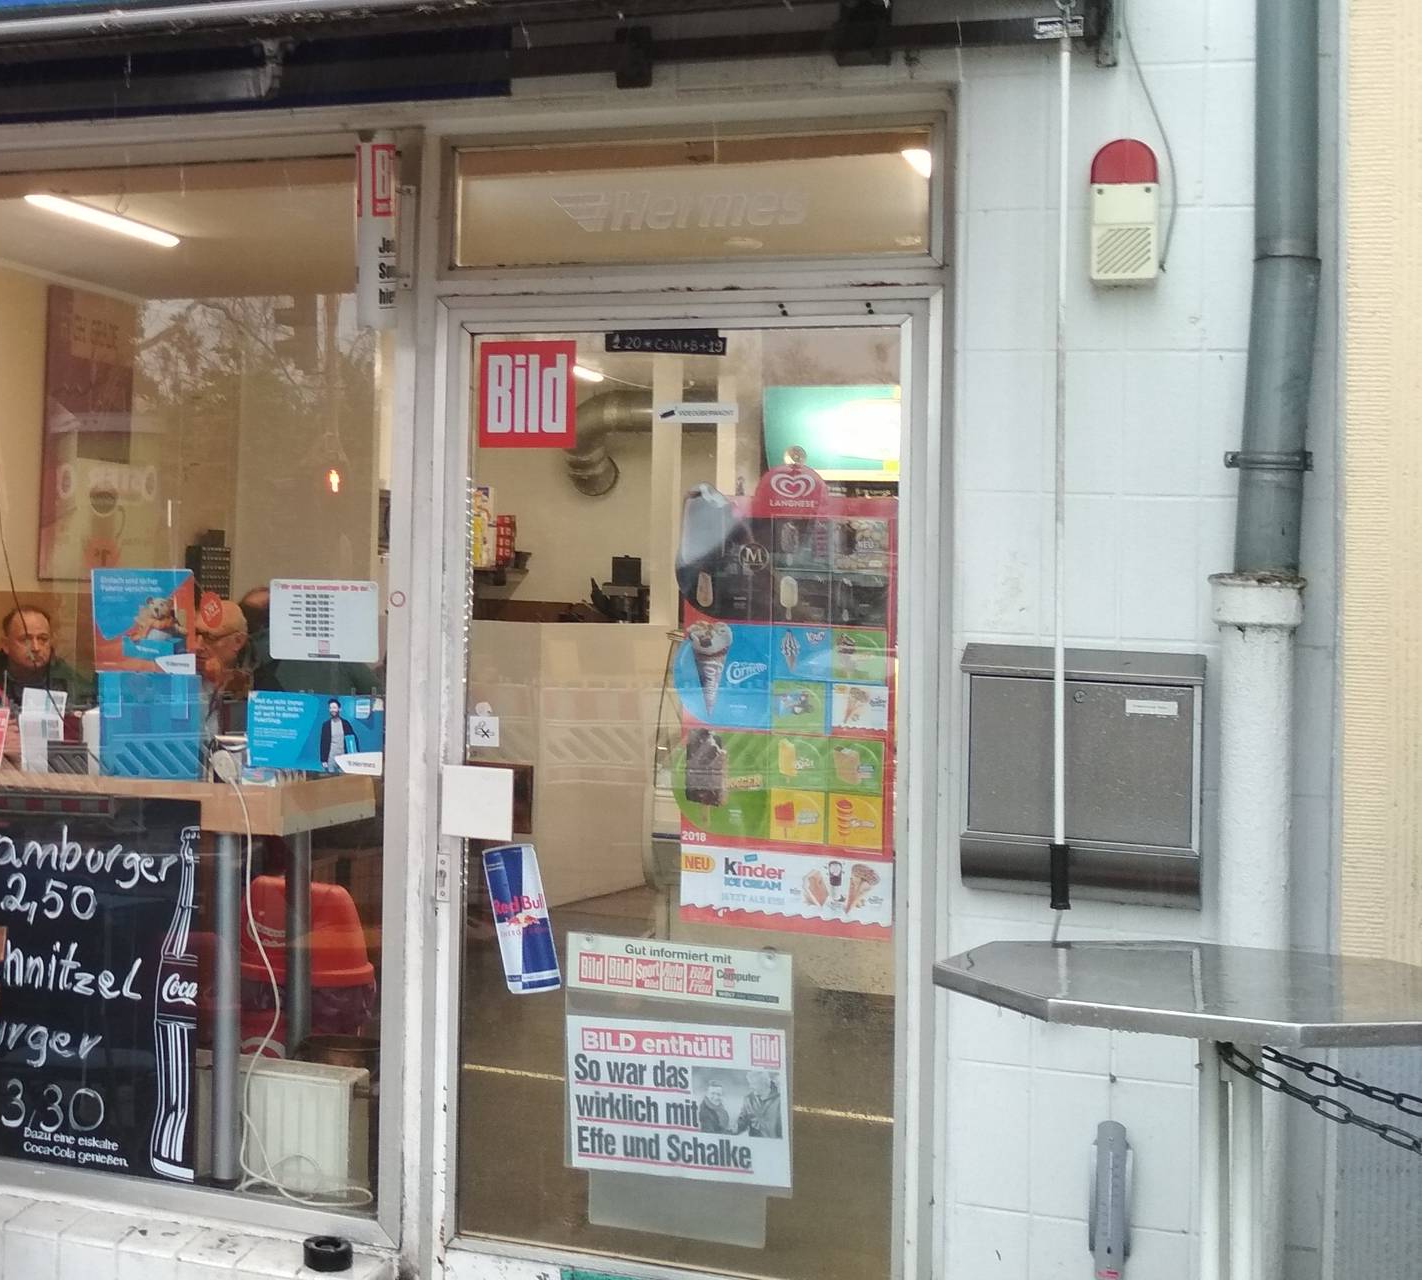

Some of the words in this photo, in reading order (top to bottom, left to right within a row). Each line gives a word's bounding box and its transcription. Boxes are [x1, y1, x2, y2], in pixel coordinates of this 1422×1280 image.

[609, 189, 807, 231] Hermes
[487, 352, 568, 434] Bild
[769, 499, 816, 508] LANGNESE
[682, 831, 706, 842] 2018
[684, 855, 710, 870] NEU
[724, 856, 785, 879] Kinder
[724, 879, 741, 888] ICE
[0, 872, 99, 925] 2,50
[493, 895, 520, 914] Red
[521, 893, 544, 910] Bull
[625, 944, 646, 956] Gut
[649, 947, 709, 962] informiert
[712, 953, 732, 965] mit
[580, 955, 603, 981] Bild
[608, 956, 633, 980] Bild
[716, 968, 761, 984] Computer
[162, 973, 198, 1006] Coca
[582, 1029, 636, 1052] BILD
[642, 1033, 732, 1058] enthüllt
[752, 1034, 780, 1062] Bild
[574, 1053, 602, 1082] So
[606, 1061, 647, 1085] war
[653, 1060, 690, 1090] das
[0, 1078, 105, 1133] 3,30
[575, 1090, 659, 1124] wirklich
[665, 1100, 700, 1128] mit
[23, 1126, 52, 1142] Dazu
[53, 1132, 76, 1145] eine
[78, 1136, 119, 1151] eiskalte
[23, 1141, 76, 1159] Coca-Cola
[577, 1125, 617, 1156] Effe
[622, 1133, 661, 1161] und
[667, 1133, 753, 1169] Schalke
